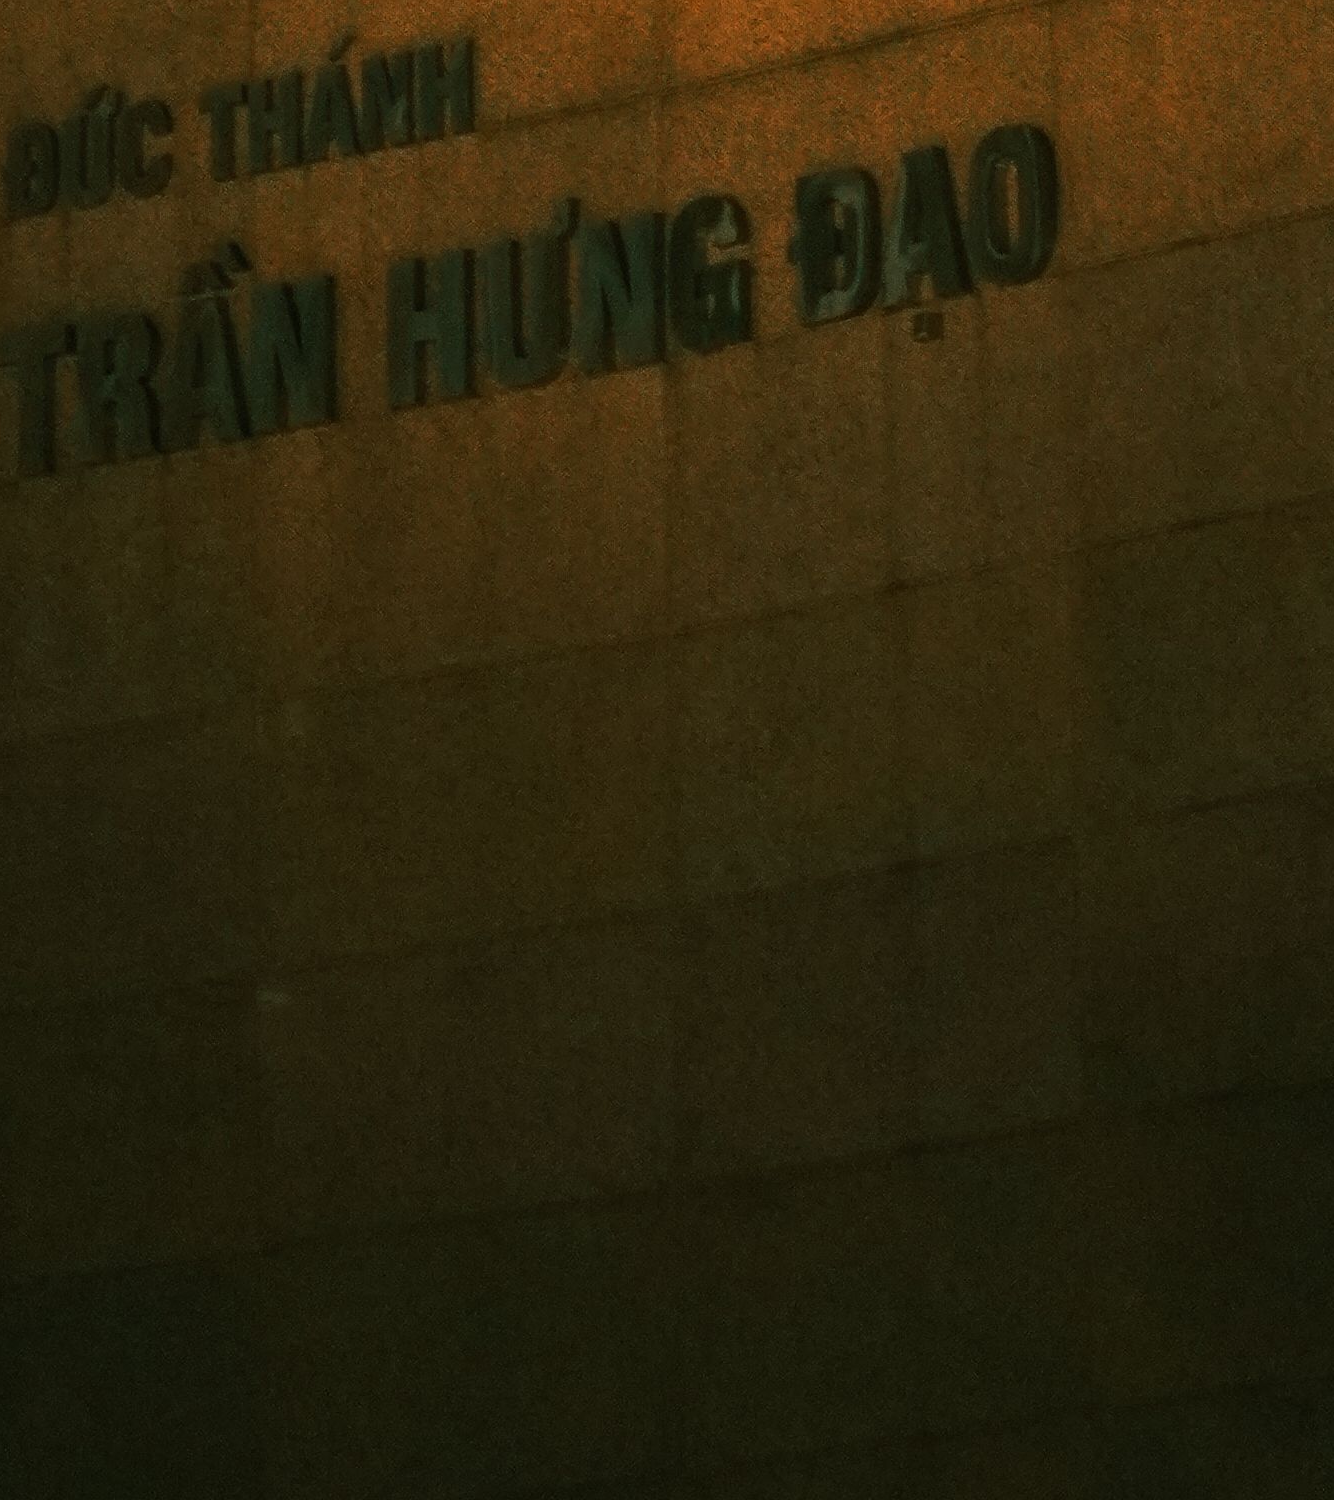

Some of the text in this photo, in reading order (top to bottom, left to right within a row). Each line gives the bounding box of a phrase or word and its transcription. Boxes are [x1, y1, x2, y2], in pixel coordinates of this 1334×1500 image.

[3, 26, 477, 218] ĐỨC THÁNH
[385, 196, 753, 412] HƯNG
[790, 121, 1059, 344] ĐẠO
